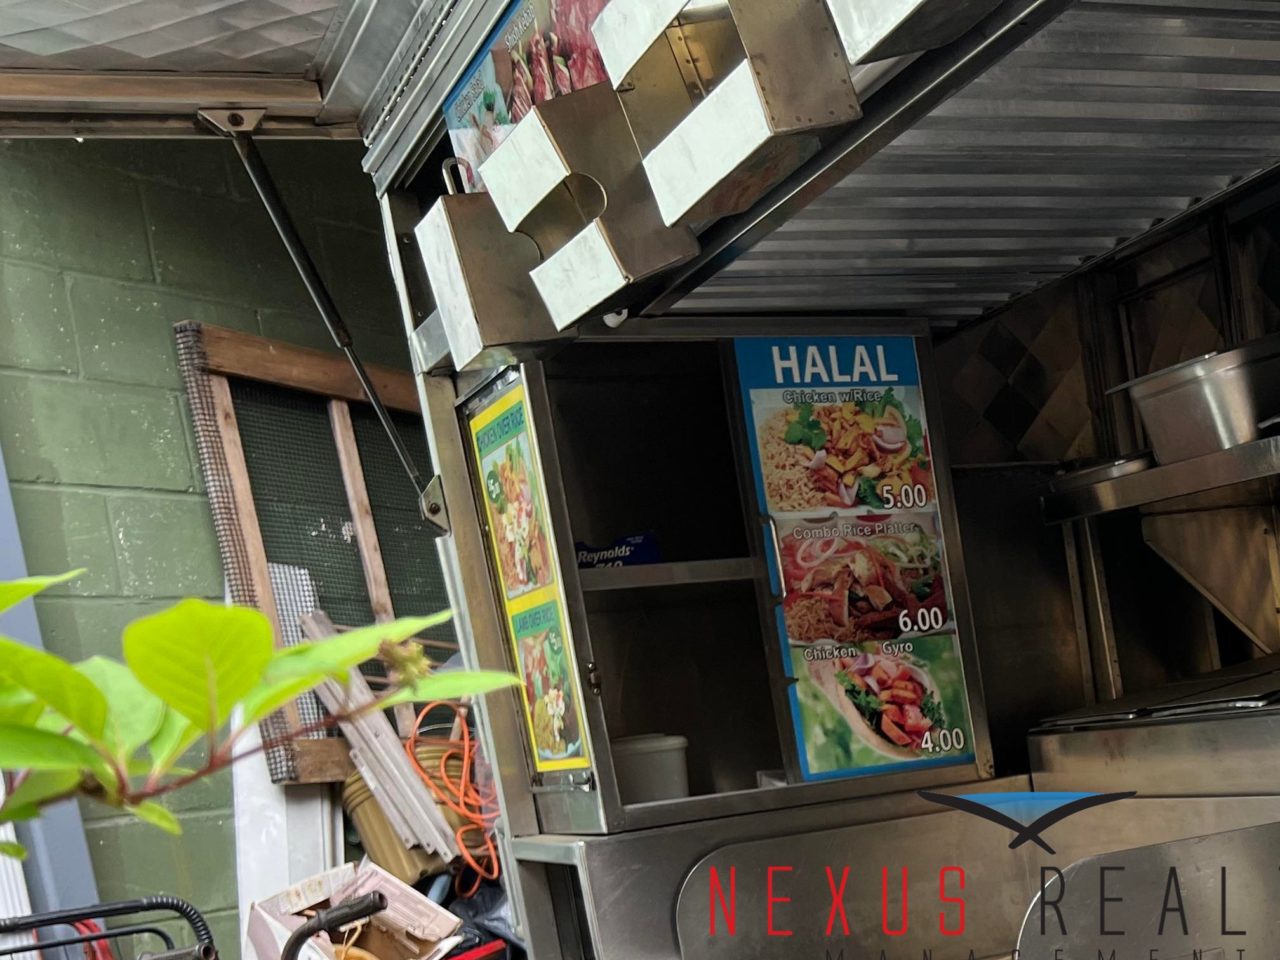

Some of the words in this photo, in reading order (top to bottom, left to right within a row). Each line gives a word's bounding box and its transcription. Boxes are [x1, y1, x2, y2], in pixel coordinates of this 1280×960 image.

[771, 345, 899, 384] HALAL
[783, 389, 837, 404] Chicken
[838, 389, 882, 404] w/Rice
[882, 484, 927, 509] 5.00
[793, 526, 839, 540] Combo
[843, 524, 871, 537] Rice
[875, 521, 916, 536] Platter
[578, 545, 630, 564] Reynolds
[899, 607, 943, 632] 6.00
[803, 645, 857, 661] Chicken
[882, 641, 913, 656] Gyro
[921, 728, 964, 753] 4.00
